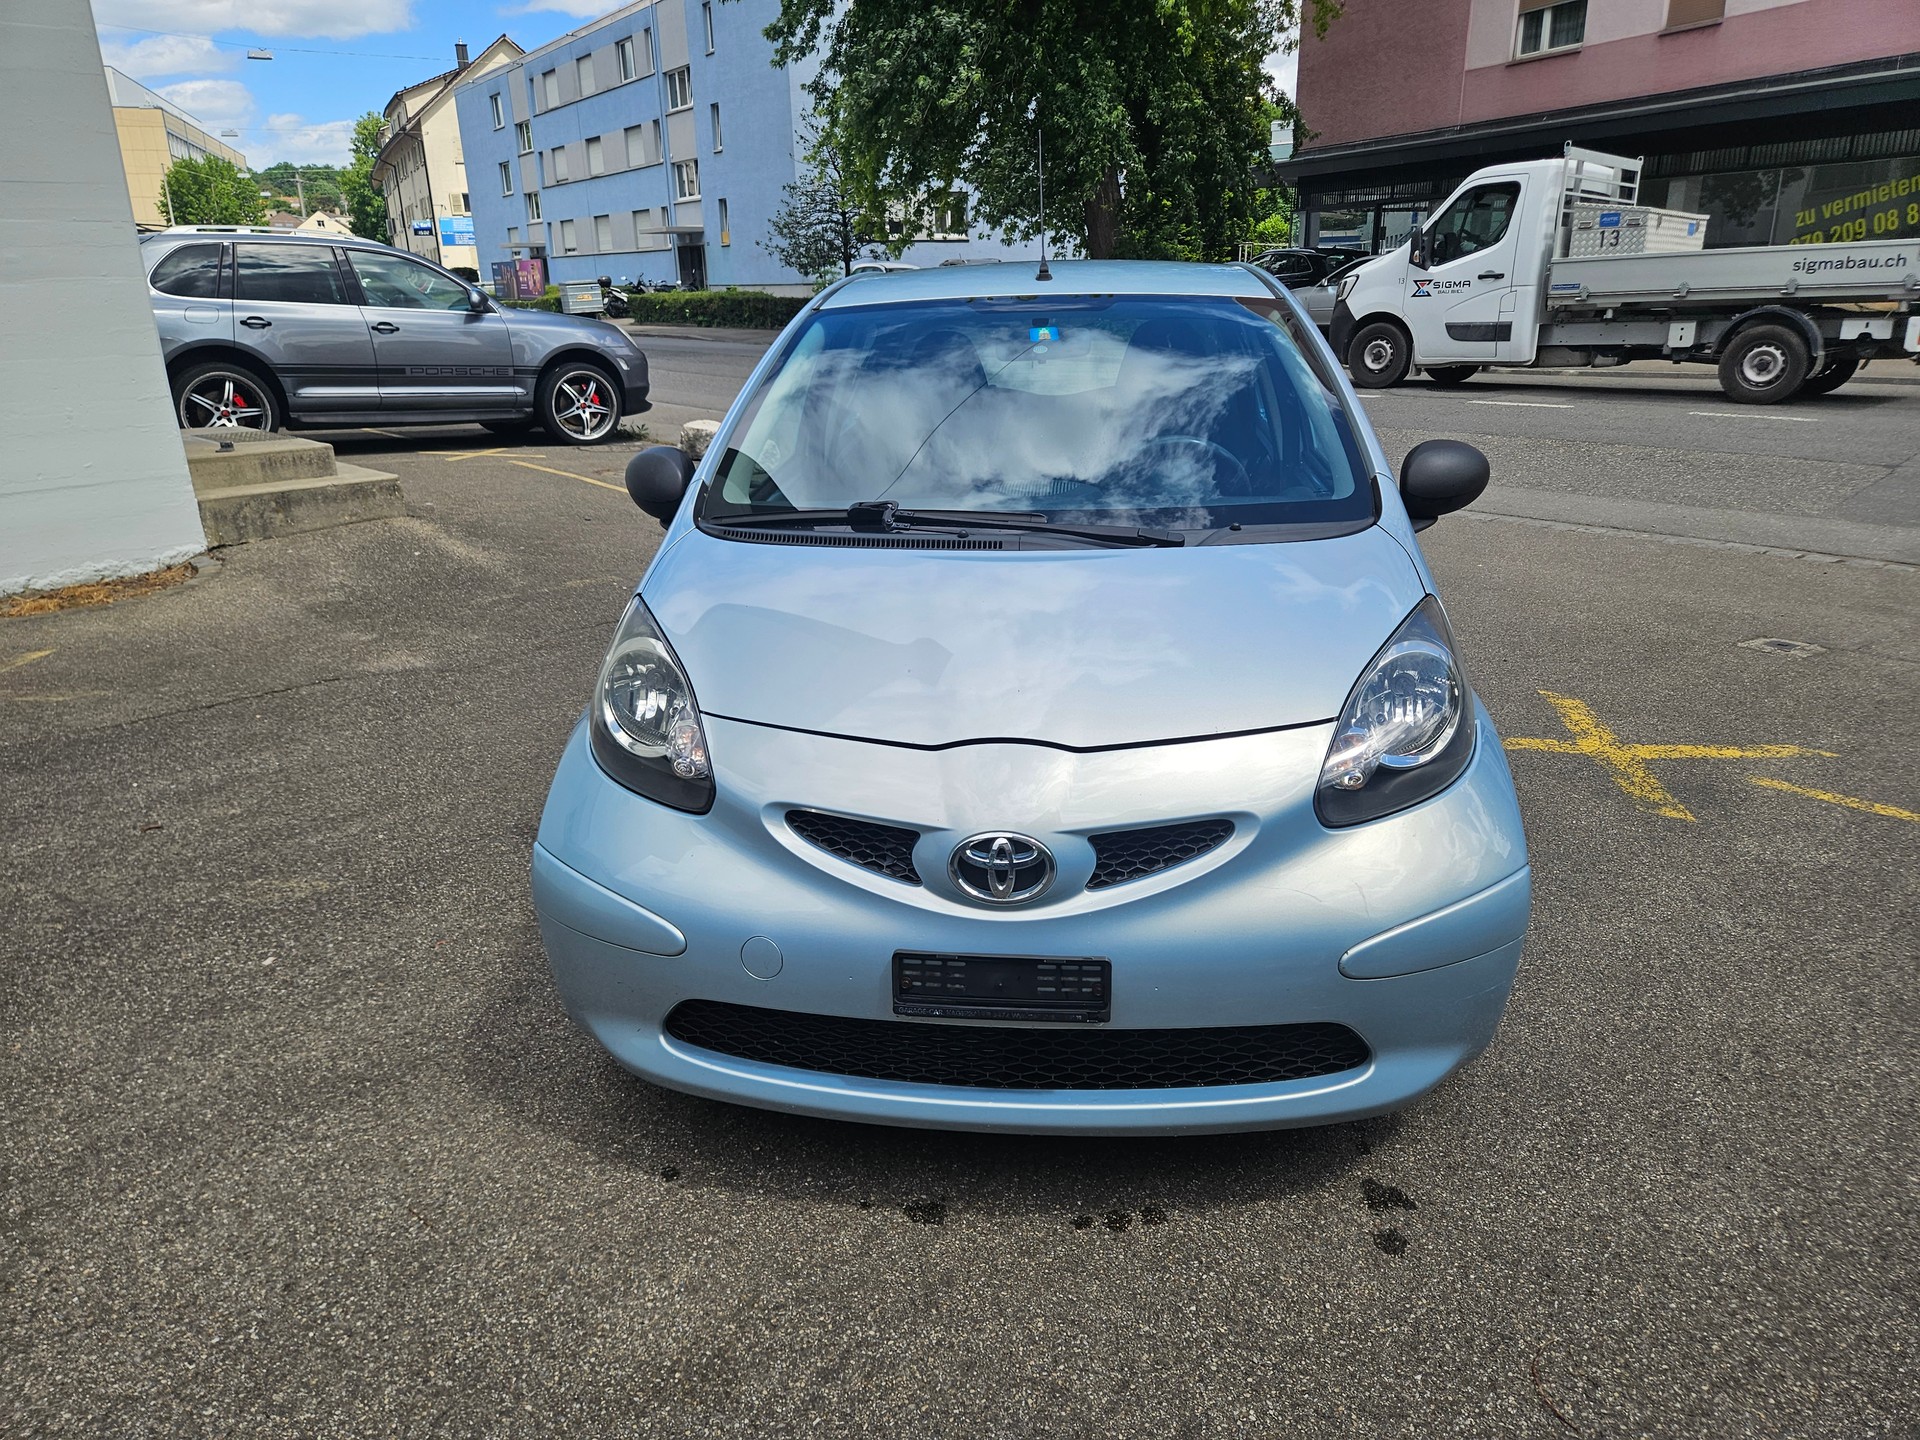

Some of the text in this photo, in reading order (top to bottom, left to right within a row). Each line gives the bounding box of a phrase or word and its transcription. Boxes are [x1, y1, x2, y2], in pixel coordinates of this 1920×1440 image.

[1795, 174, 1920, 228] zu vermieten
[1829, 218, 1867, 243] 209
[1873, 209, 1899, 234] 08
[1600, 229, 1620, 248] 13
[1792, 253, 1907, 275] sigmabau.ch
[1433, 280, 1471, 289] SIGMA
[410, 367, 510, 376] PORSCHE
